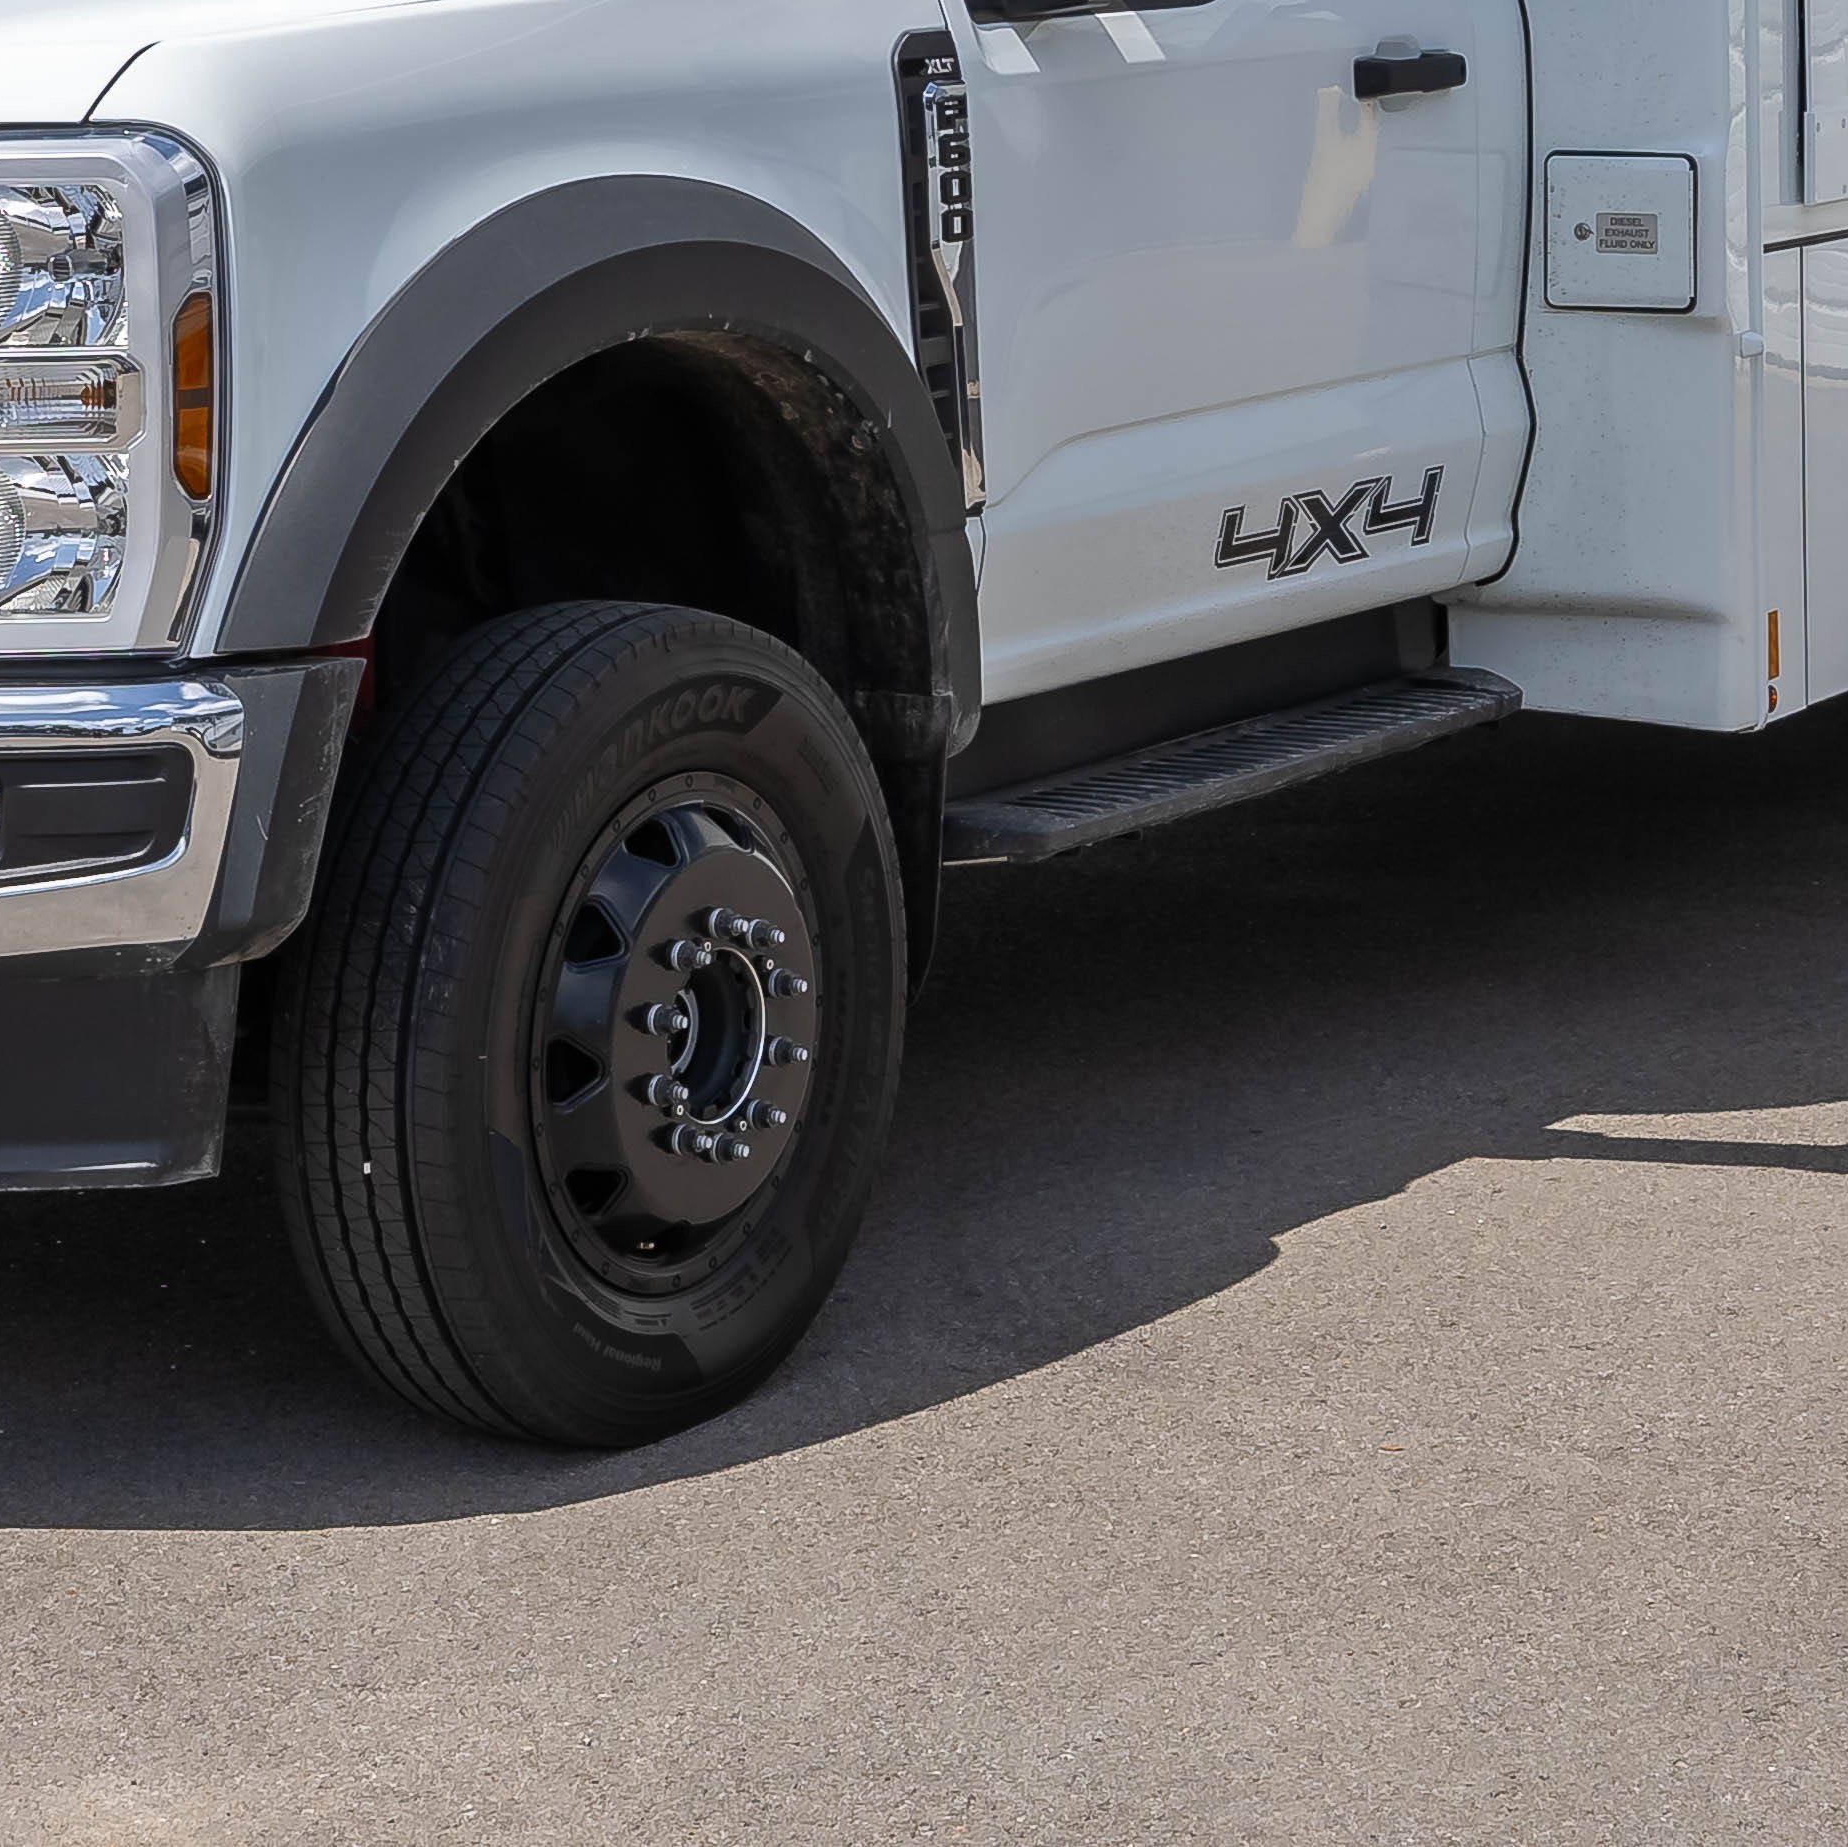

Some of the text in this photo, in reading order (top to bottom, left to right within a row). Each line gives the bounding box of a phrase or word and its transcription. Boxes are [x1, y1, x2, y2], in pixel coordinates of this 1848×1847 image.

[924, 56, 955, 76] XLT
[1610, 217, 1644, 227] DIESEL
[1604, 228, 1650, 238] EXHAUST
[1600, 239, 1655, 249] FLUID ONLY
